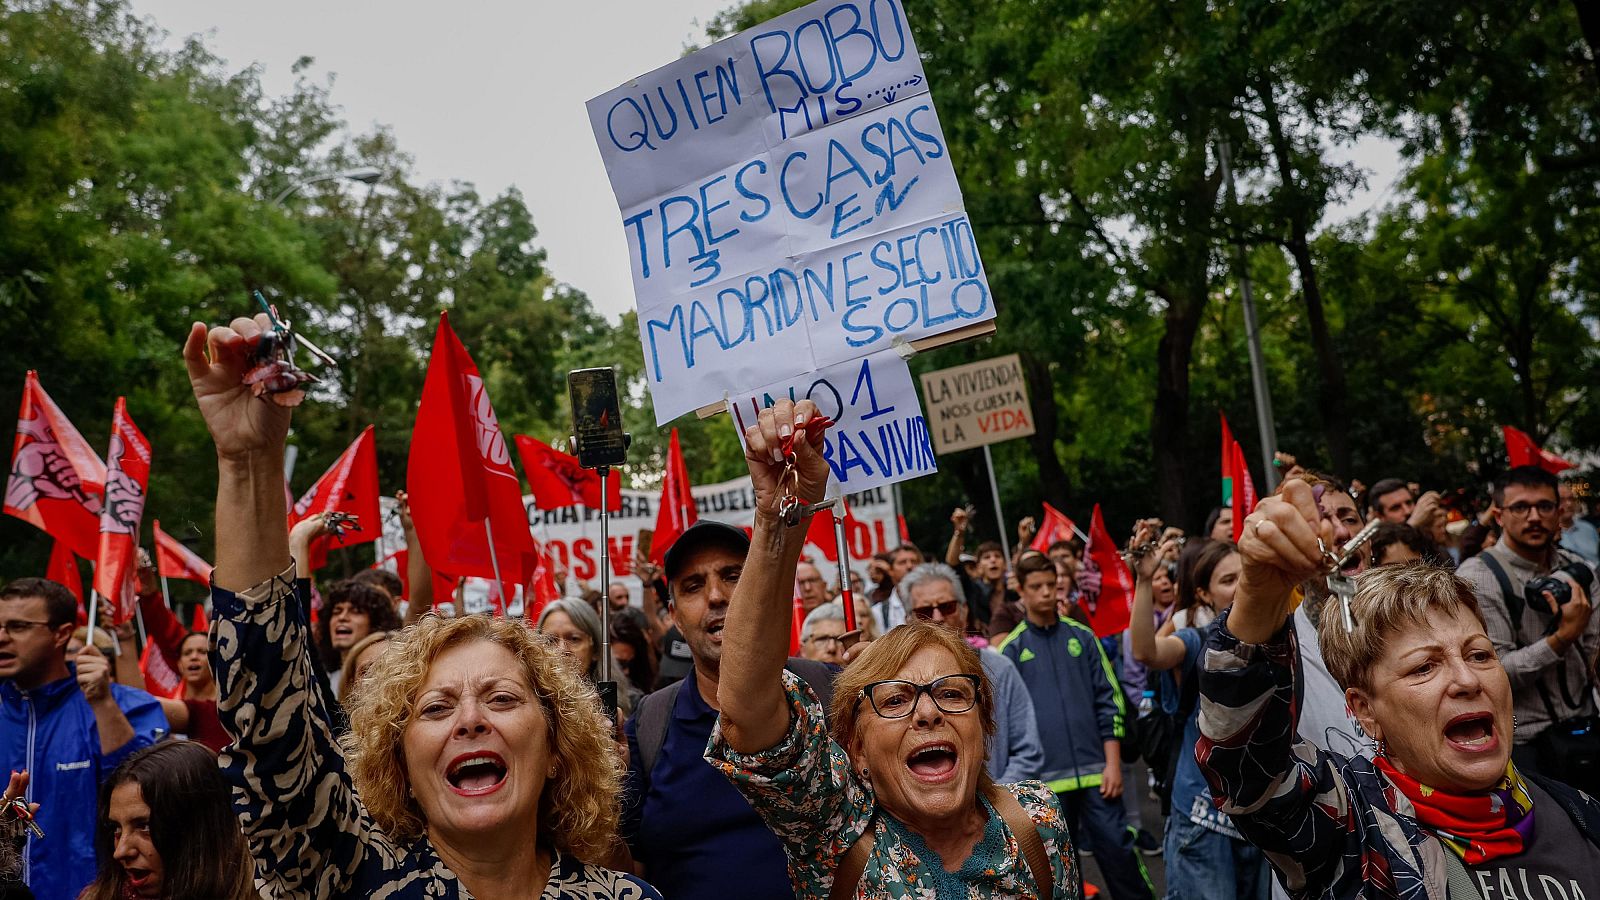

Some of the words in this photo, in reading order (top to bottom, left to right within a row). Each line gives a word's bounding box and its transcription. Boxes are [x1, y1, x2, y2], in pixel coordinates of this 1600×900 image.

[607, 57, 741, 152] QUIEN
[750, 0, 905, 113] ROBO
[778, 81, 862, 140] MIS
[623, 159, 772, 279] TRES
[779, 105, 944, 219] CASAS
[830, 176, 919, 238] EN
[688, 248, 721, 288] 3
[647, 267, 804, 383] MADRID
[803, 216, 981, 322] NESECITO
[841, 277, 988, 348] SOLO
[850, 358, 895, 421] 1
[927, 379, 952, 404] LA
[951, 361, 1021, 396] VIVIENDA
[940, 402, 973, 421] NOS
[973, 390, 1024, 413] CUESTA
[942, 422, 966, 444] LA
[977, 408, 1029, 434] VIDA
